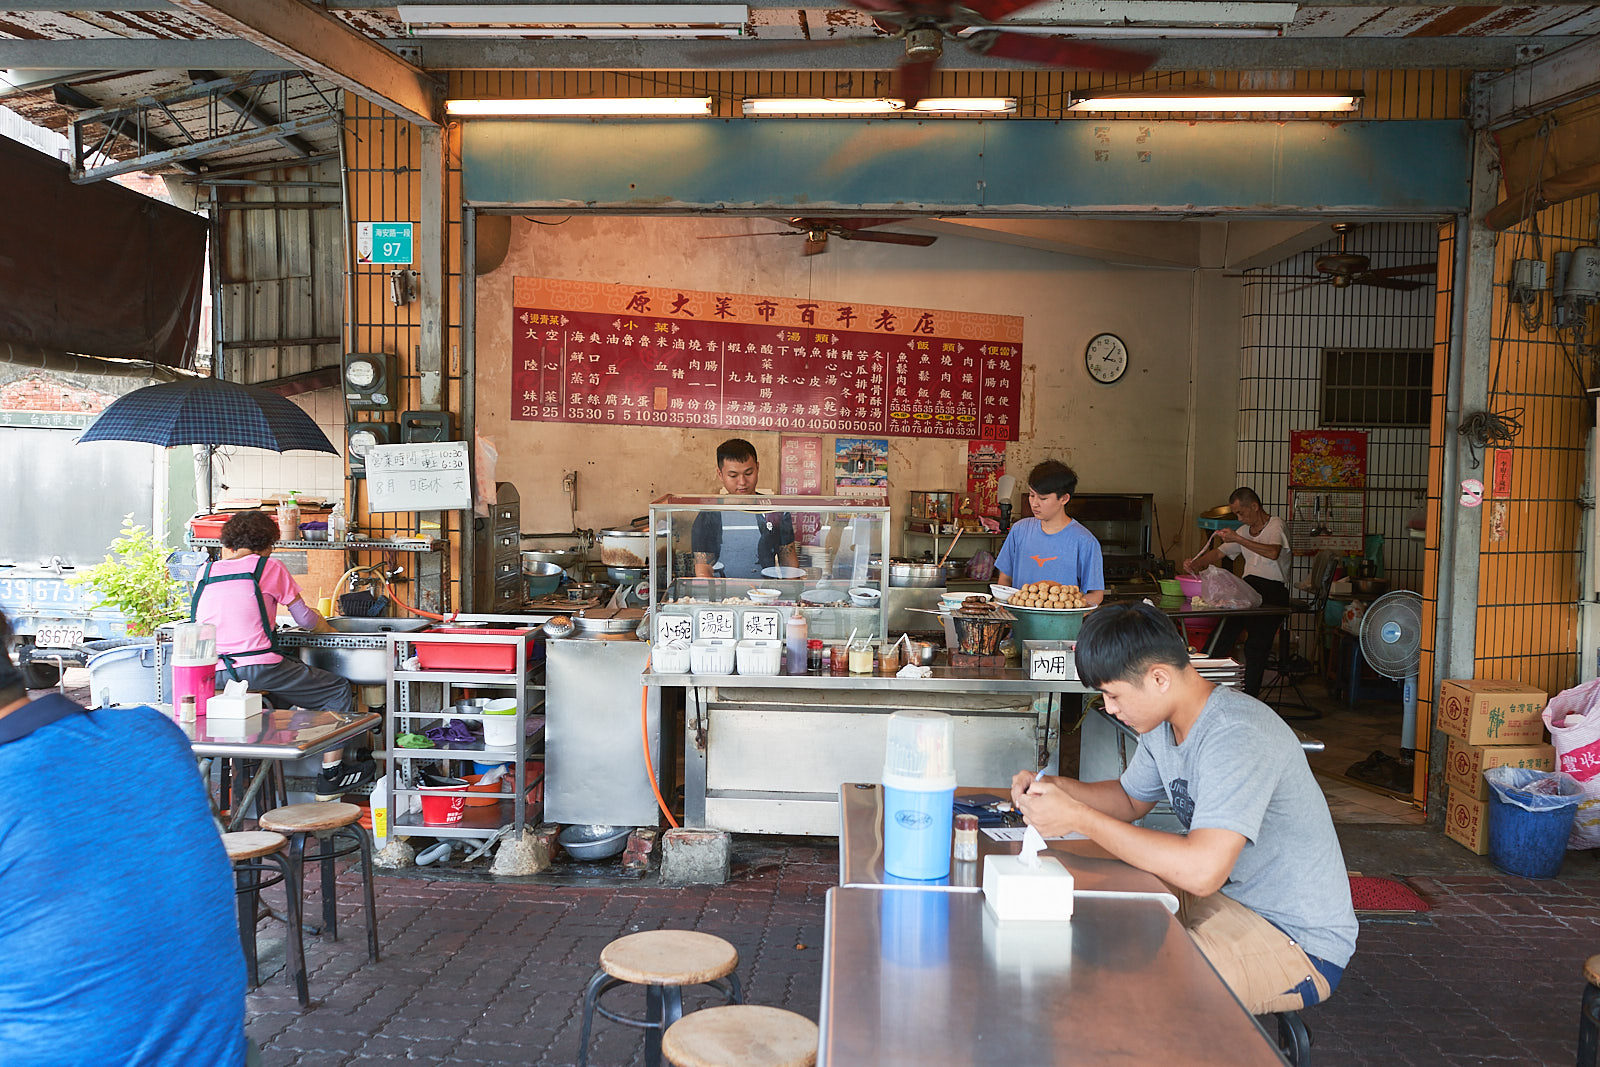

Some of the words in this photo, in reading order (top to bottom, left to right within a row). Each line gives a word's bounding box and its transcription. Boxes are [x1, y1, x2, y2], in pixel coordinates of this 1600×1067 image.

[383, 242, 401, 256] 97
[626, 290, 935, 334] 原大菜市百年老店
[624, 320, 668, 333] 小菜
[786, 332, 829, 344] 湯類
[988, 346, 1010, 356] 便當
[522, 328, 539, 402] 大陸妹
[544, 330, 558, 402] 空心菜
[570, 331, 586, 404] 海鮮蒸蛋
[604, 334, 620, 406] 油豆腐
[621, 334, 634, 406] 魯丸
[637, 335, 651, 408] 魯蛋
[670, 338, 685, 410] 滷豬腸
[688, 339, 702, 410] 燒肉一份
[704, 340, 718, 410] 香腸一份
[726, 343, 741, 412] 蝦丸湯
[743, 343, 757, 412] 魚丸湯
[940, 354, 953, 399] 燒肉飯
[760, 344, 774, 414] 酸菜豬腸湯
[776, 346, 789, 414] 下水湯
[792, 346, 806, 416] 鴨心湯
[808, 347, 822, 416] 魚皮湯
[840, 350, 853, 418] 豬心冬粉
[854, 350, 868, 418] 苦瓜排骨湯
[870, 350, 884, 419] 冬粉排骨酥湯
[984, 359, 996, 424] 香腸便當
[998, 360, 1011, 424] 燒肉便當
[522, 406, 538, 416] 25
[542, 406, 558, 418] 25
[568, 408, 584, 418] 35
[586, 408, 602, 419] 30
[890, 404, 900, 412] 55
[901, 404, 910, 412] 35
[912, 404, 922, 412] 55
[924, 405, 933, 413] 35
[934, 406, 944, 414] 55
[946, 406, 954, 414] 35
[31, 414, 92, 426] 台南市東門
[607, 410, 614, 420] 5
[624, 410, 630, 420] 5
[636, 410, 650, 420] 10
[652, 412, 668, 422] 30
[670, 413, 684, 422] 35
[686, 414, 700, 424] 50
[702, 414, 717, 424] 35
[726, 414, 740, 426] 30
[742, 415, 756, 426] 30
[758, 416, 772, 426] 40
[775, 417, 789, 428] 40
[791, 418, 805, 428] 40
[807, 418, 822, 429] 40
[822, 419, 836, 430] 50
[838, 420, 852, 430] 50
[853, 420, 867, 431] 50
[868, 422, 882, 432] 50
[889, 424, 900, 432] 75
[923, 426, 932, 434] 40
[966, 428, 976, 436] 20
[440, 450, 462, 458] 10:30
[442, 460, 462, 468] 6:30
[702, 612, 732, 634] 湯匙
[746, 616, 776, 635] 碟子
[660, 620, 690, 640] 小碗
[37, 630, 84, 644] 3S-6732
